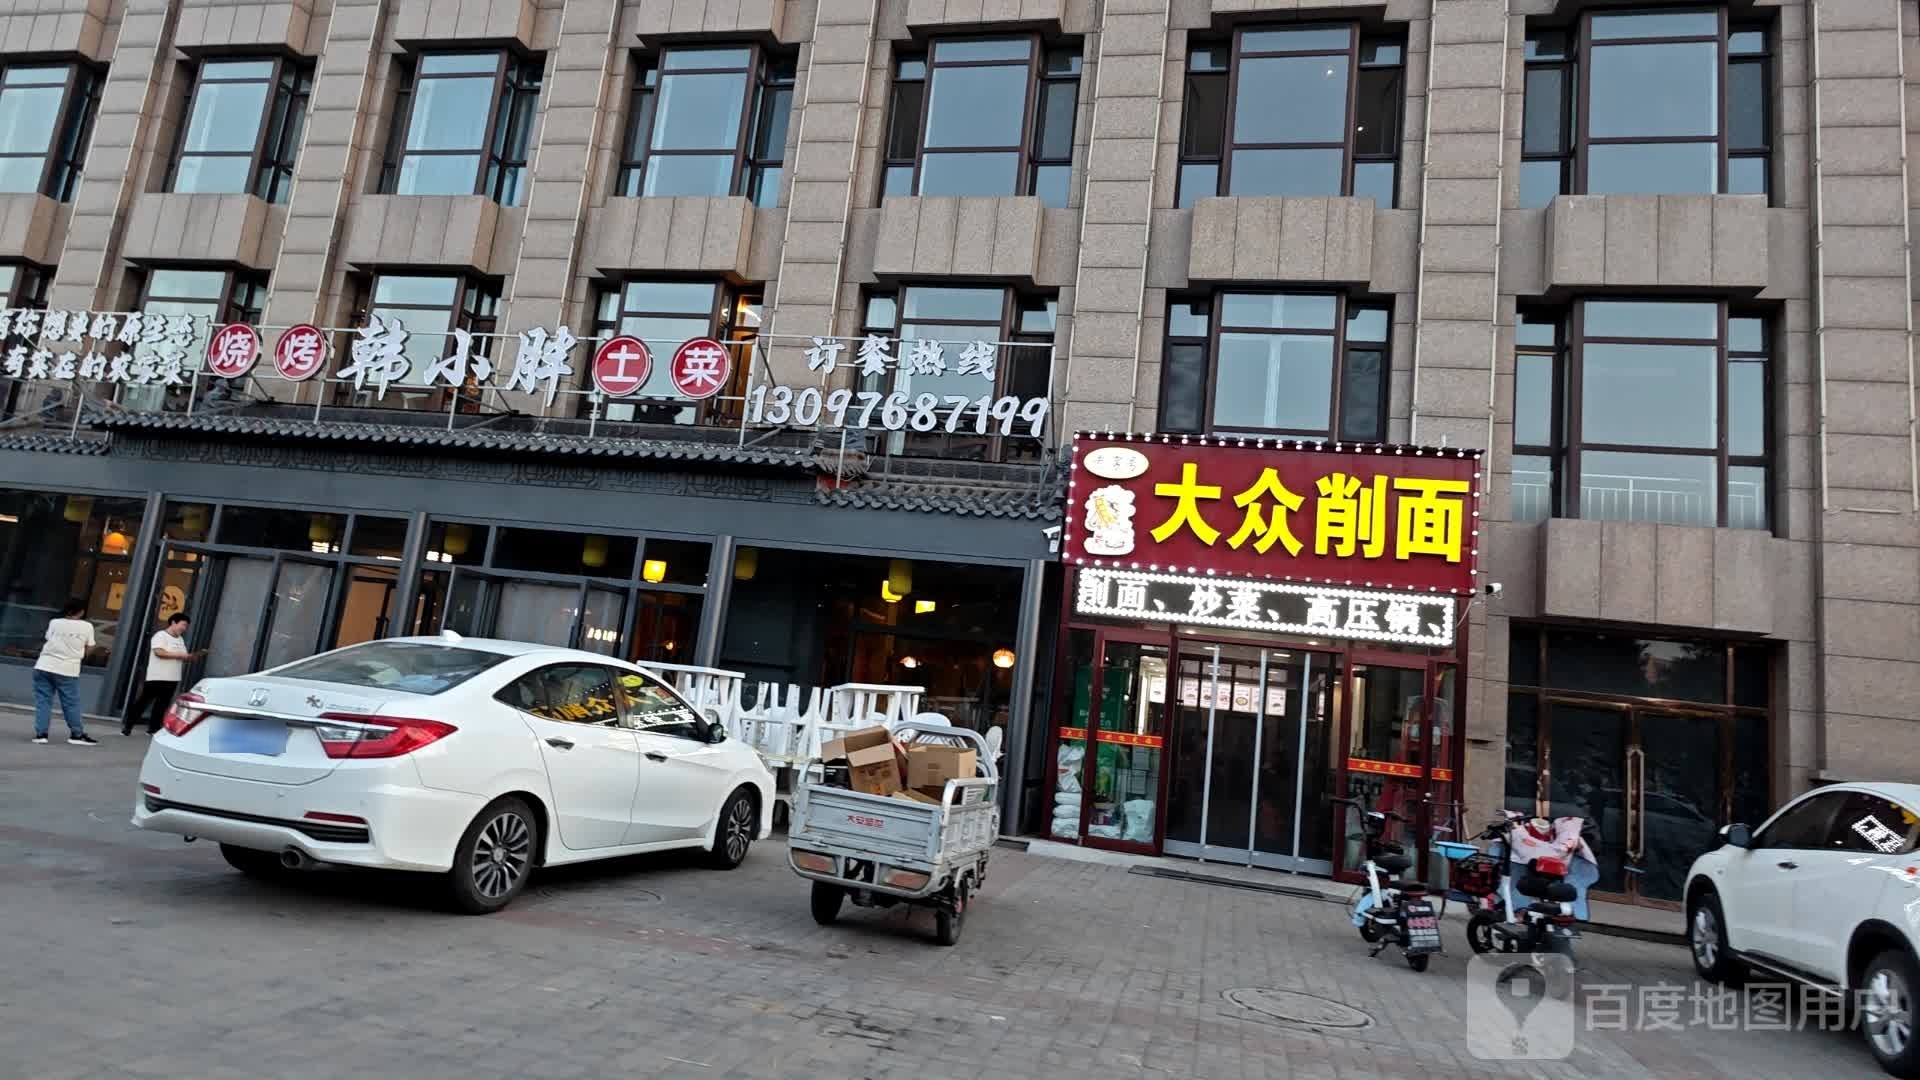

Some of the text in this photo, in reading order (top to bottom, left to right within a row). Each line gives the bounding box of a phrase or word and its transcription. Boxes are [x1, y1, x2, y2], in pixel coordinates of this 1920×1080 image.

[217, 314, 722, 406] 烧烤 韩小胖 土菜
[804, 334, 996, 381] 订餐热线
[751, 384, 1049, 438] 13097687199
[1150, 463, 1470, 563] 大众削面
